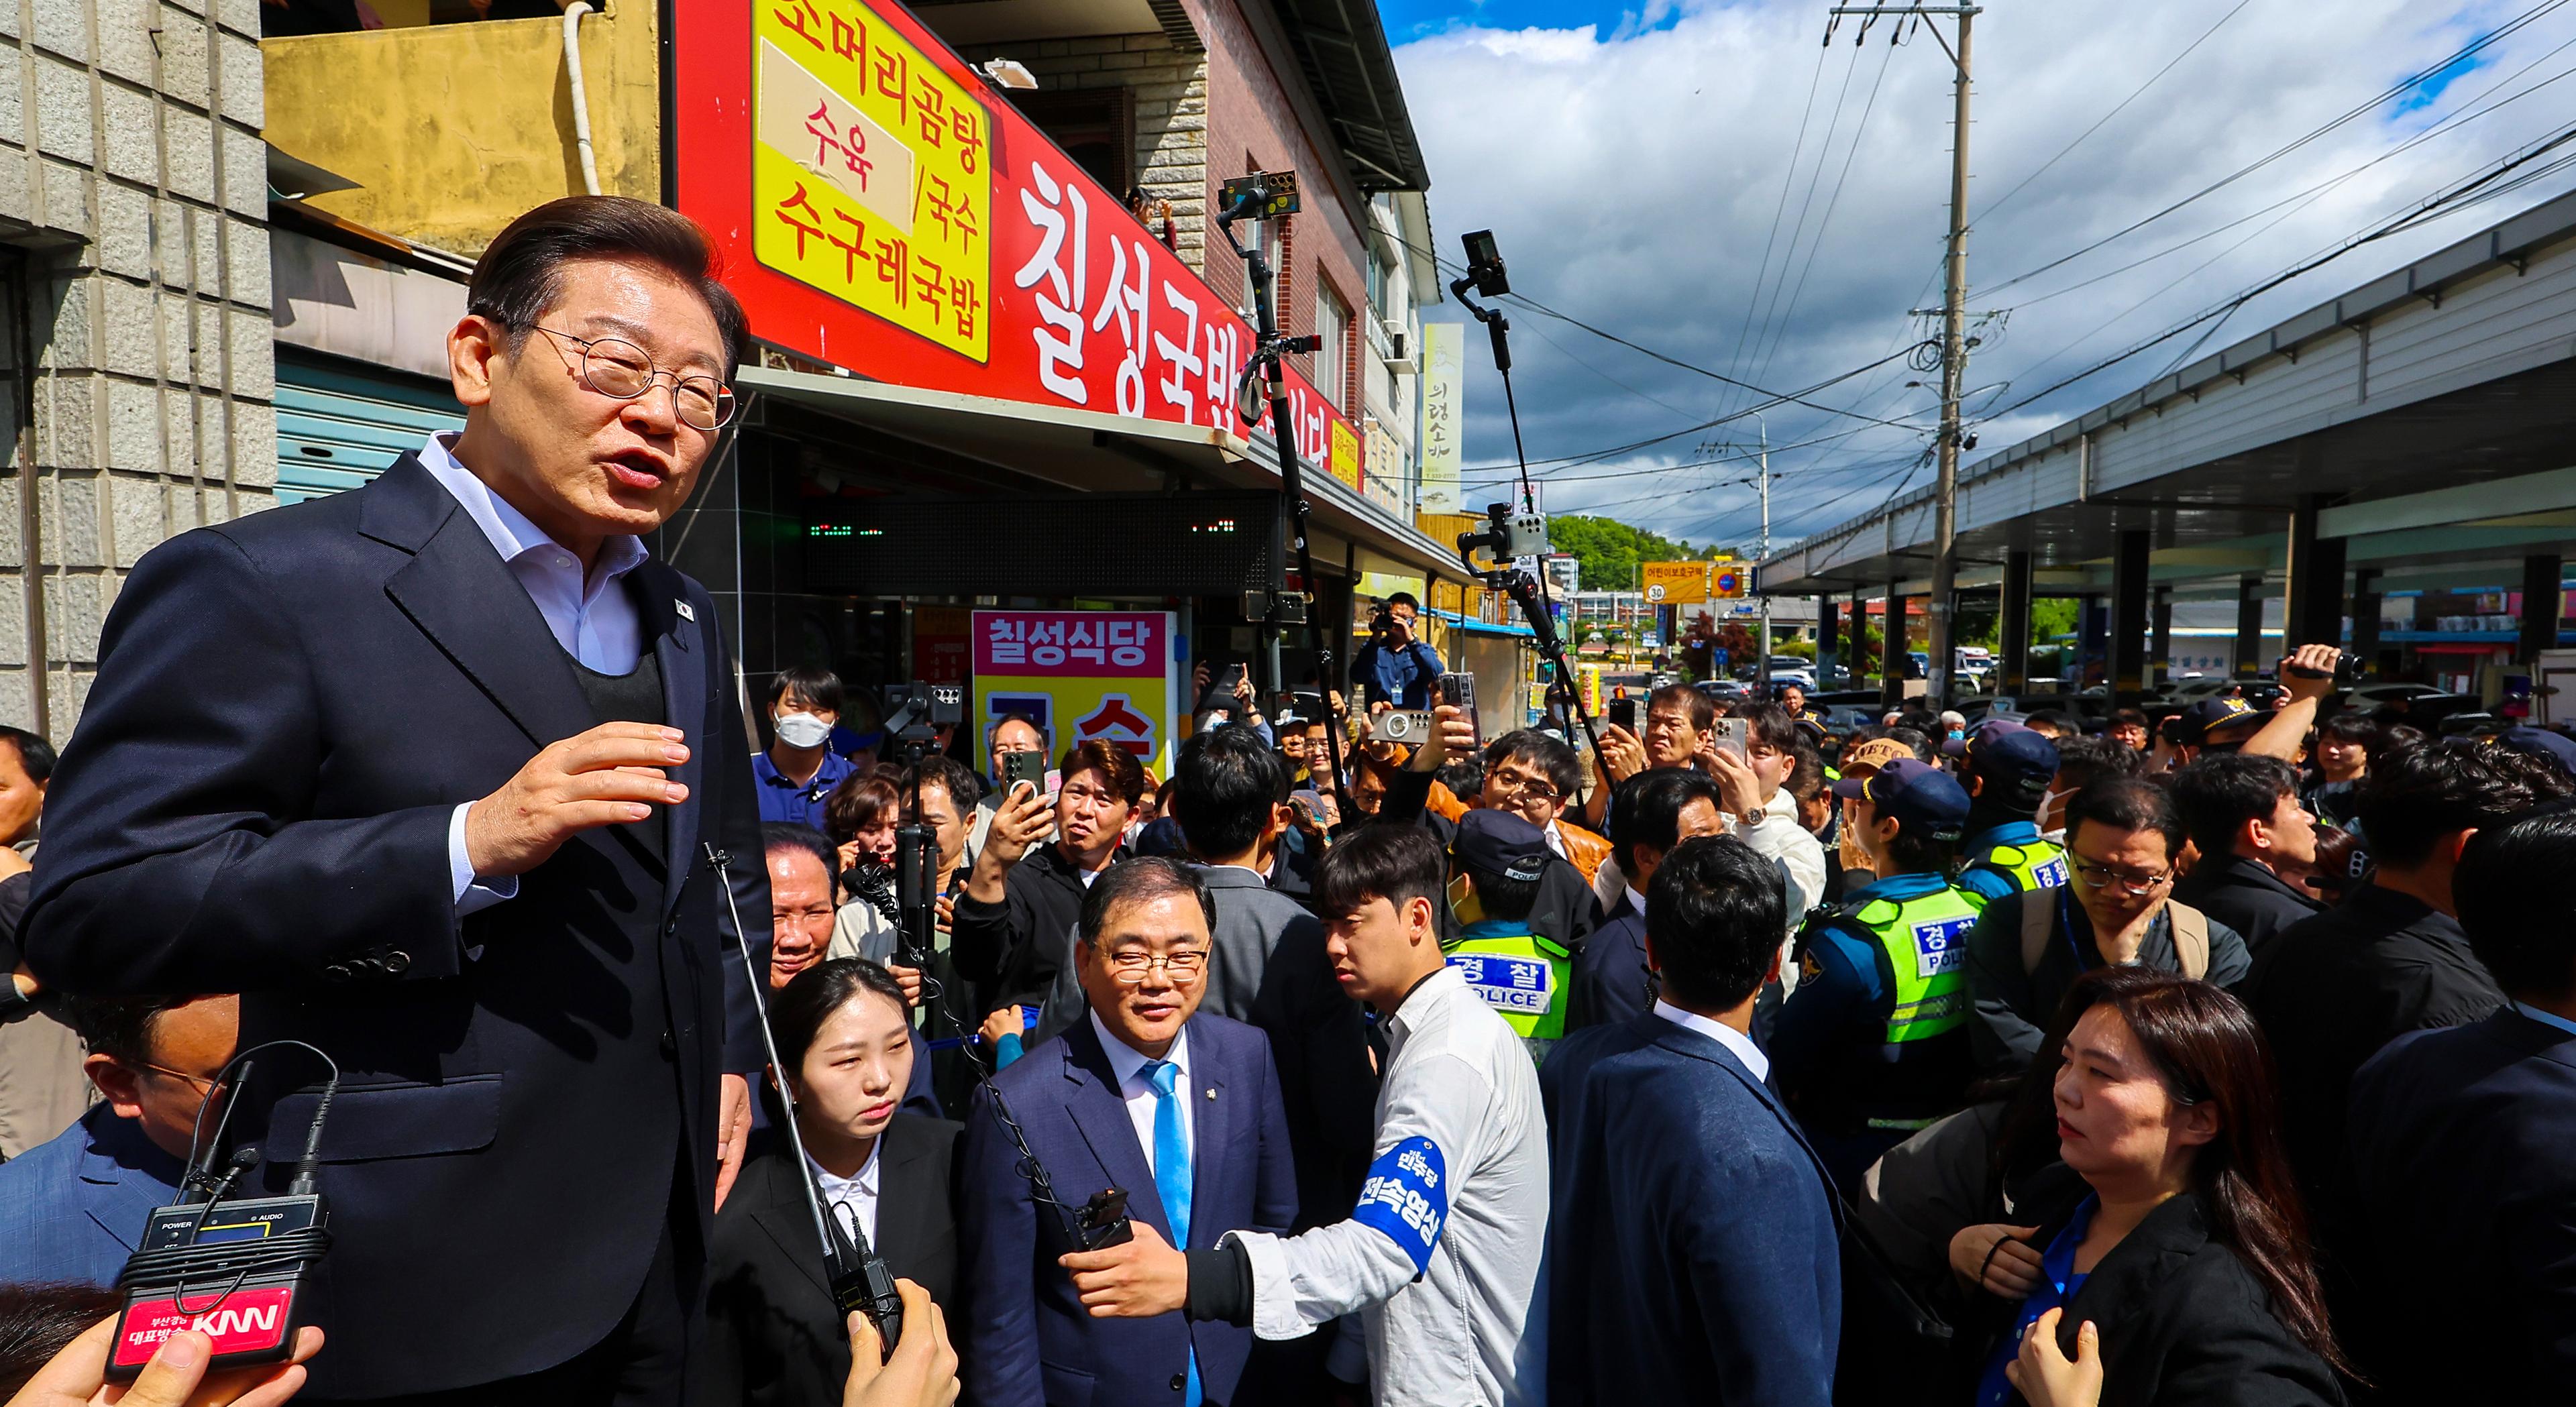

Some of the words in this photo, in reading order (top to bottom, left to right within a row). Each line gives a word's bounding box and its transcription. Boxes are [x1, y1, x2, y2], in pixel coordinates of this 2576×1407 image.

[804, 97, 873, 193] 수육
[774, 181, 981, 340] 수구레국밥
[1652, 588, 1662, 598] 30
[989, 618, 1150, 666] 칠성식당
[1472, 988, 1538, 1006] OLICE
[1397, 1153, 1438, 1188] 민주당
[162, 1221, 193, 1229] POWER
[258, 1213, 283, 1221] AUDIO
[1356, 1176, 1440, 1247] 전속영상
[150, 1316, 187, 1327] 부산경남
[191, 1304, 278, 1337] KNN
